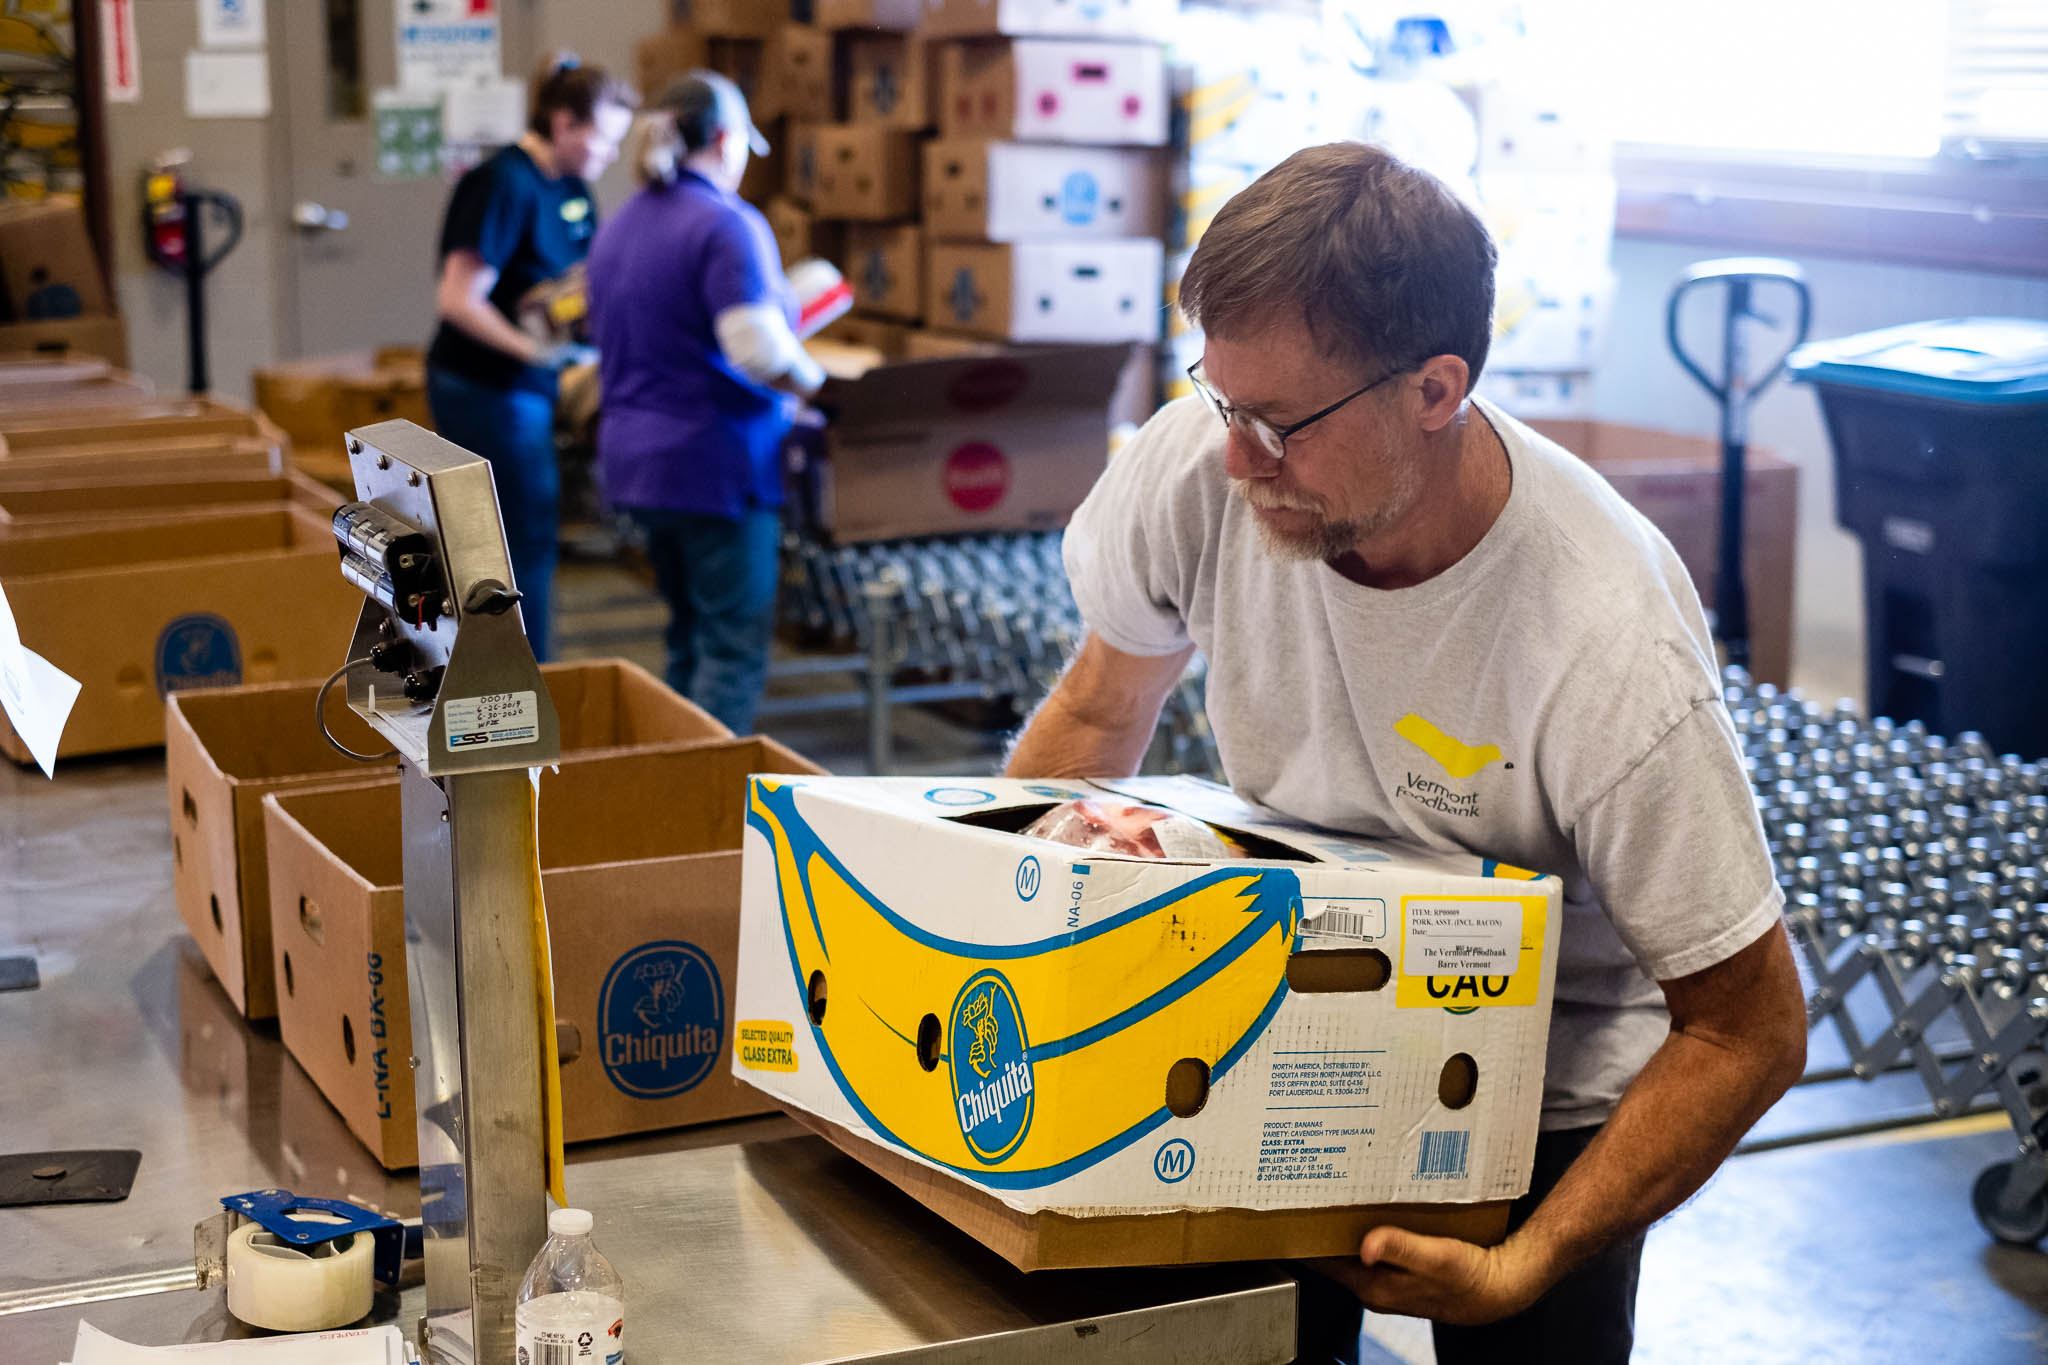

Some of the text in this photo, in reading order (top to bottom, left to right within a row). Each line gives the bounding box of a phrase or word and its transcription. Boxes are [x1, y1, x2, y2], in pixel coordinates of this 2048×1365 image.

[1408, 772, 1479, 805] Vermont
[1396, 786, 1480, 817] Foodbank
[1020, 866, 1036, 891] M
[1066, 881, 1084, 928] NA-06
[1412, 918, 1434, 927] PORK,
[1454, 919, 1475, 927] (INCL.
[1476, 920, 1502, 928] BACON)
[1424, 948, 1438, 957] The
[1438, 960, 1492, 969] Barre Vermont
[742, 1029, 794, 1044] SELECTED QUALITY
[605, 1024, 717, 1070] Chiquita
[743, 1046, 793, 1065] CLASS EXTRA
[1323, 1062, 1360, 1070] DISTRIBUTED
[958, 1060, 1033, 1134] Chiquita
[1286, 1089, 1325, 1097] LAUDERDALE,
[1294, 1121, 1323, 1129] BANANAS
[1361, 1128, 1376, 1136] AAA)
[1323, 1146, 1347, 1154] MEXICO
[1162, 1150, 1185, 1173] M
